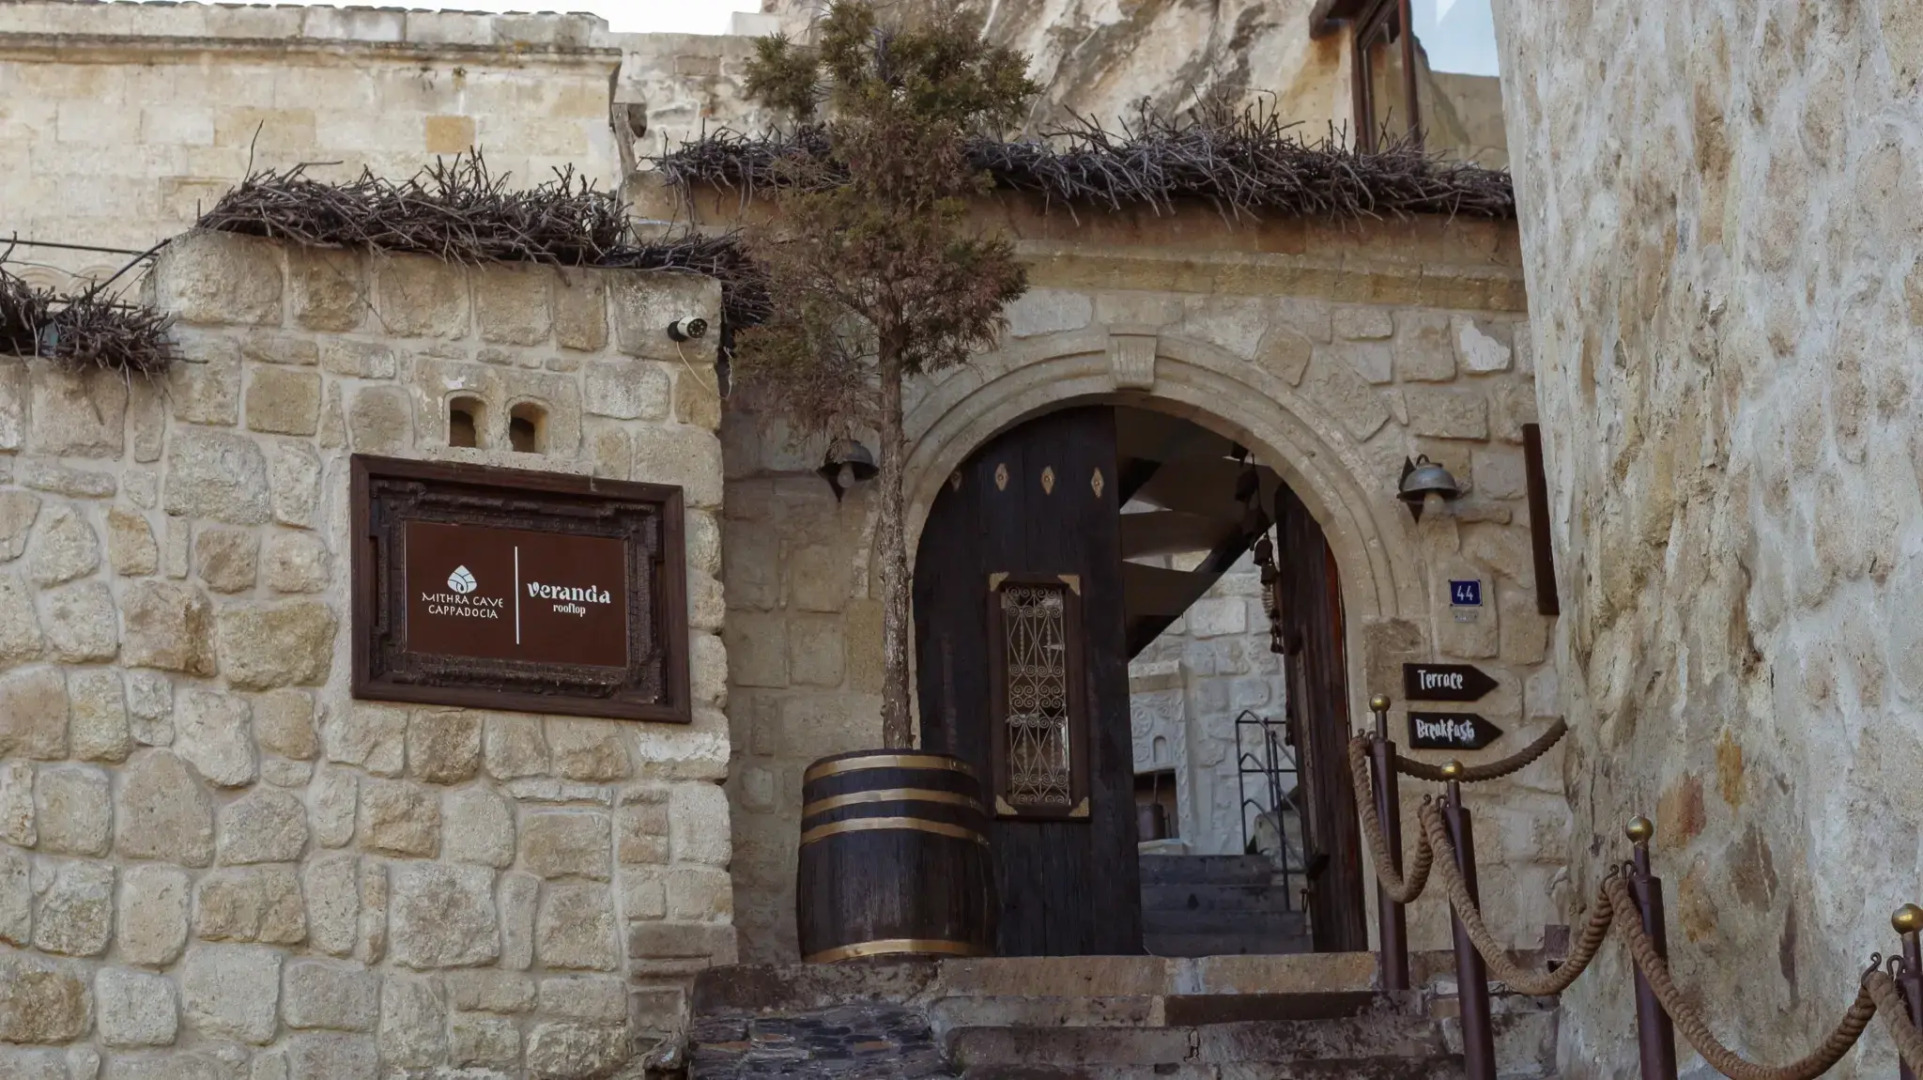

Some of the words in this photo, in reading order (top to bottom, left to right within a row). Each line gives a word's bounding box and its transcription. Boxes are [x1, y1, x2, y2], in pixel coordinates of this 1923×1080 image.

[421, 592, 470, 605] MITHRA
[472, 596, 504, 608] CAVE
[1456, 585, 1474, 601] 44
[428, 604, 499, 619] CAPPADOCIA
[553, 602, 586, 617] rooftop
[1417, 669, 1463, 690] Terrace
[1416, 718, 1475, 742] Breakfast
